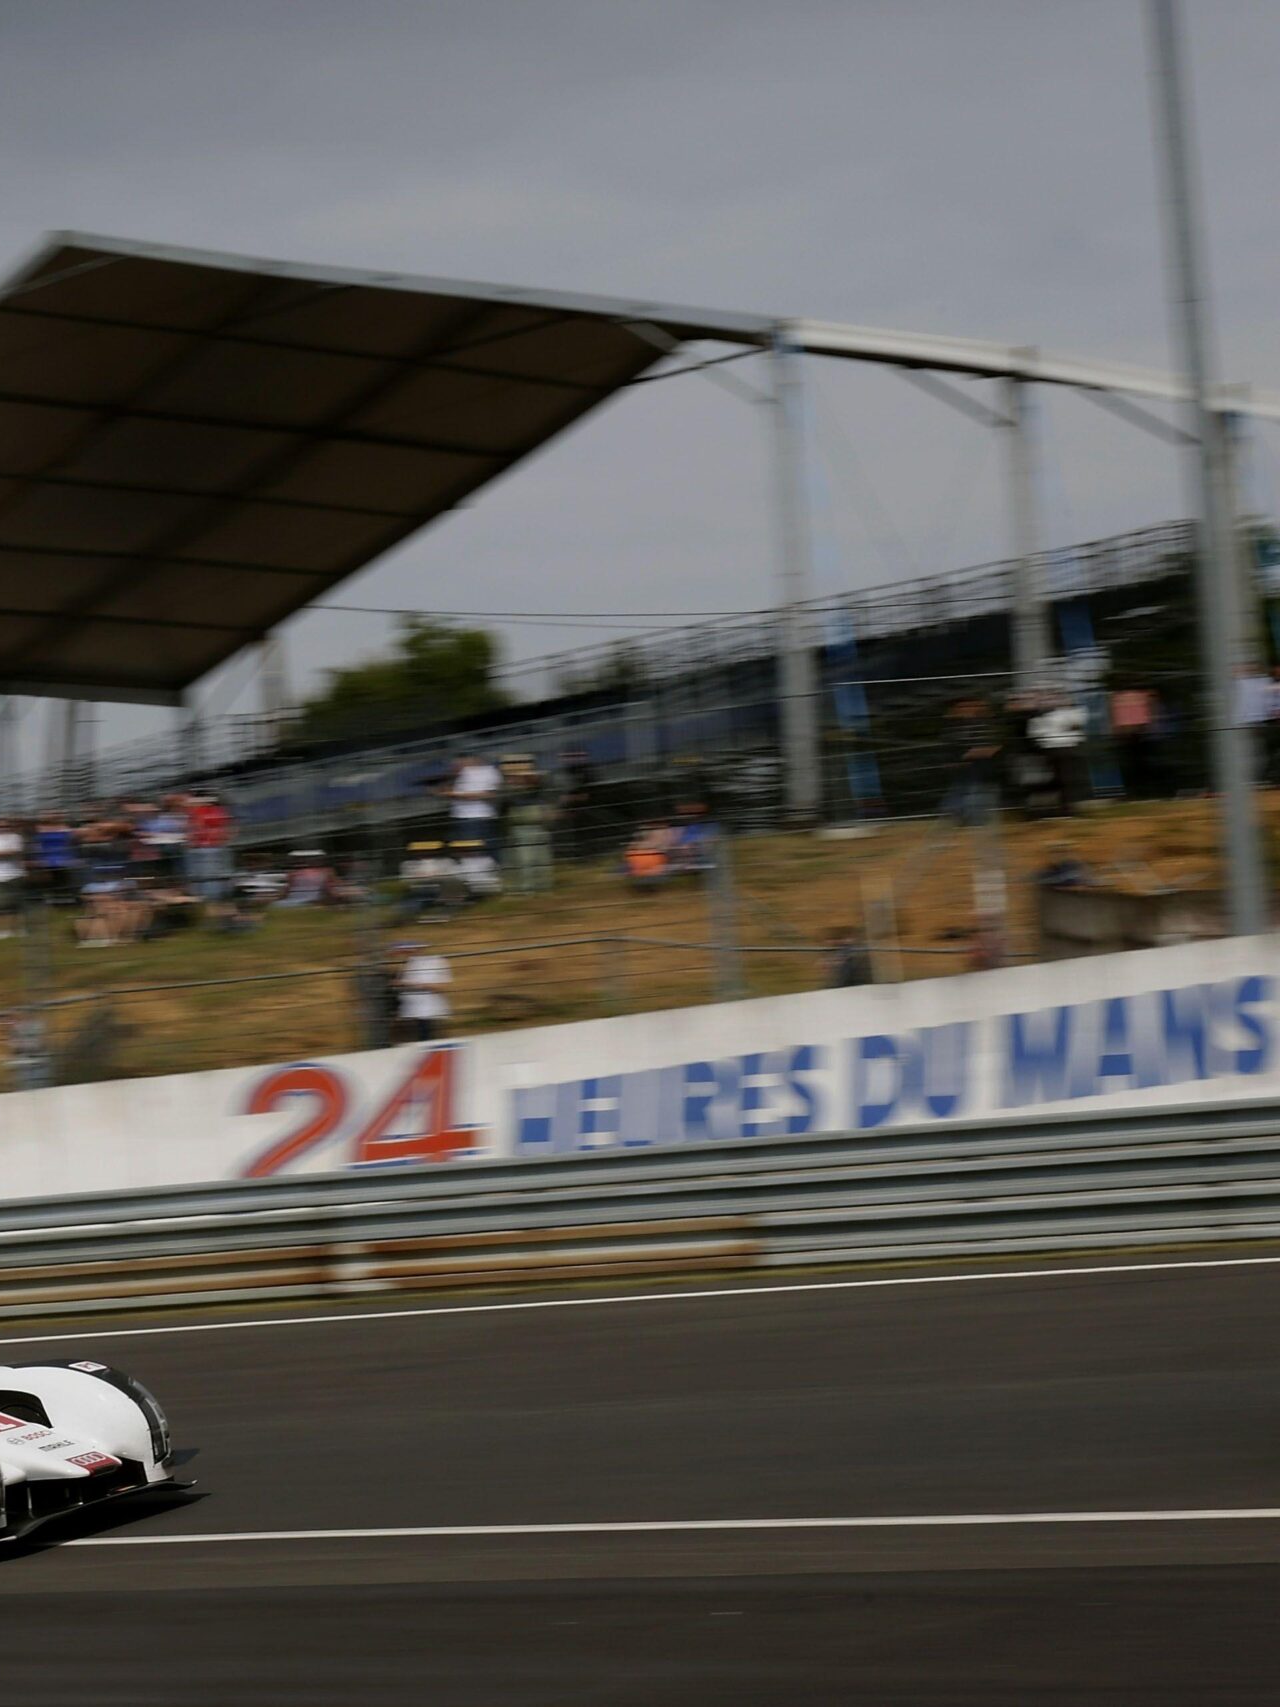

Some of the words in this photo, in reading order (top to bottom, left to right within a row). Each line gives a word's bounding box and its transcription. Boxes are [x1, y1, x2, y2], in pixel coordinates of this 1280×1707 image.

[240, 1042, 492, 1178] 24
[508, 1044, 822, 1154] HEURES
[848, 1022, 970, 1129] DU
[993, 974, 1278, 1109] MANS
